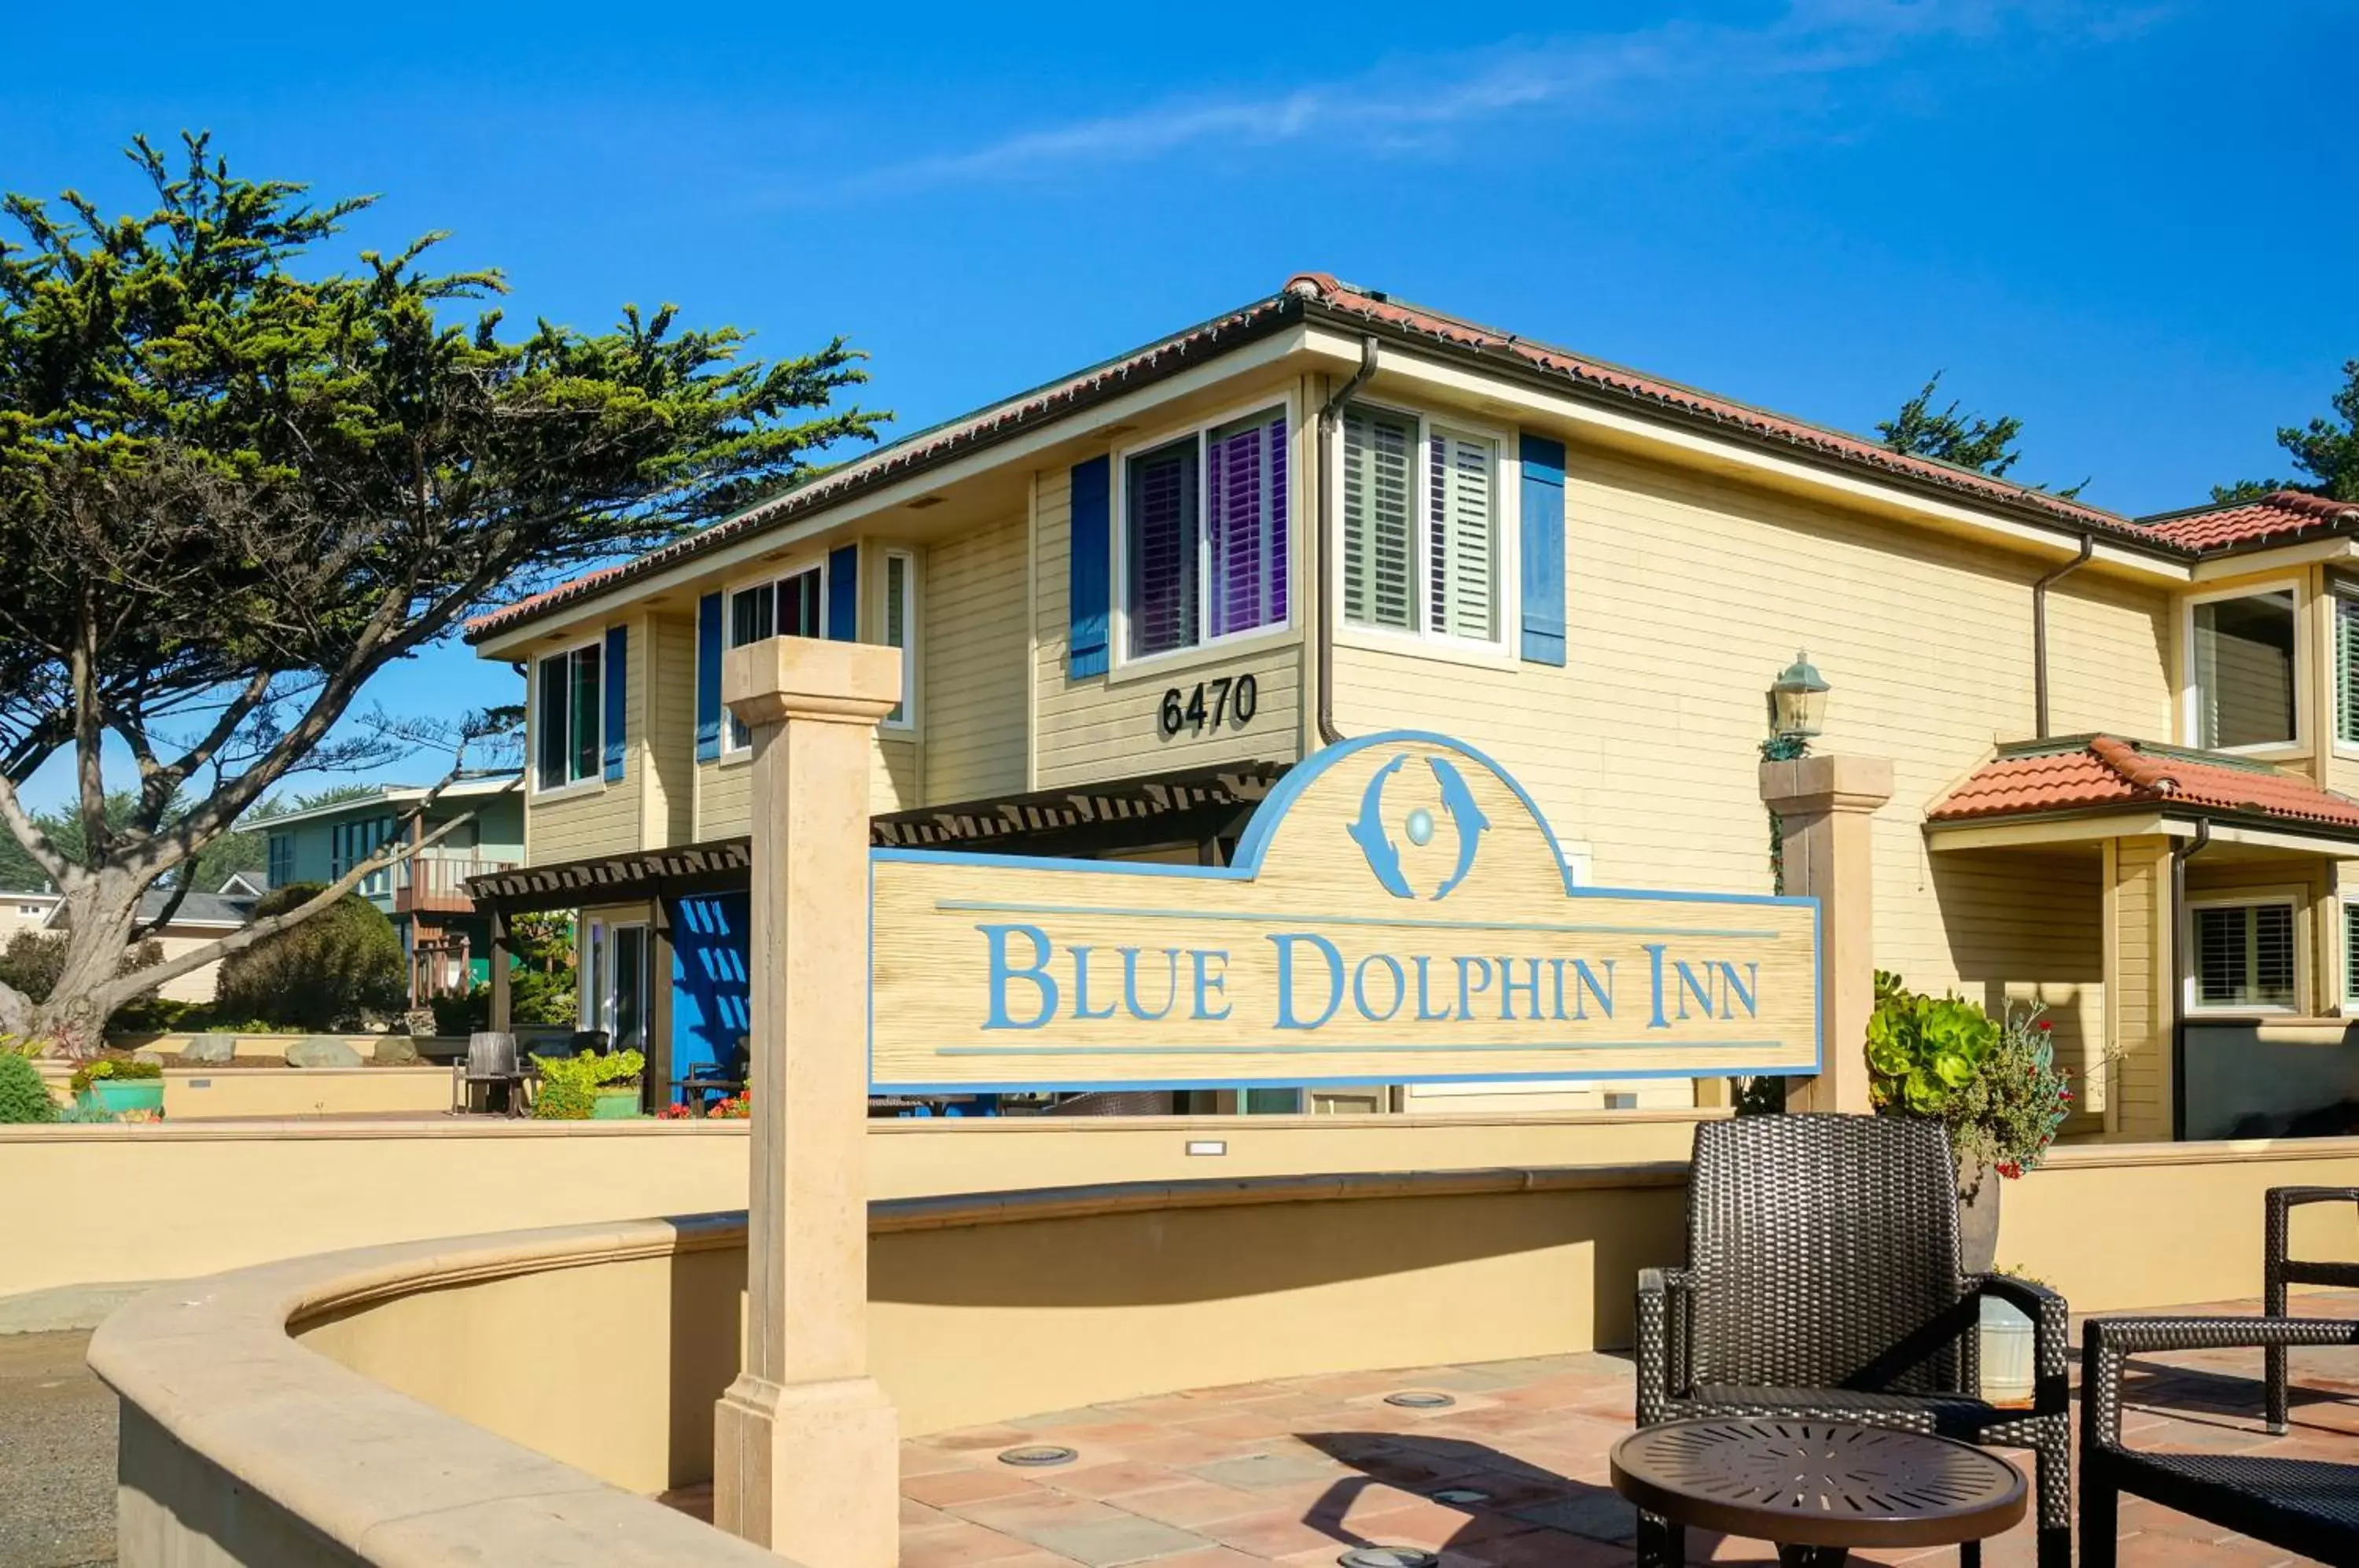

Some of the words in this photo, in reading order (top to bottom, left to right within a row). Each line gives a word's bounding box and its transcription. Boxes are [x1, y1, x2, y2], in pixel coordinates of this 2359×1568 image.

[1163, 674, 1257, 734] 6470
[976, 924, 1232, 1029] BLUE
[1267, 933, 1616, 1029] DOLPHIN
[1645, 944, 1759, 1028] INN
